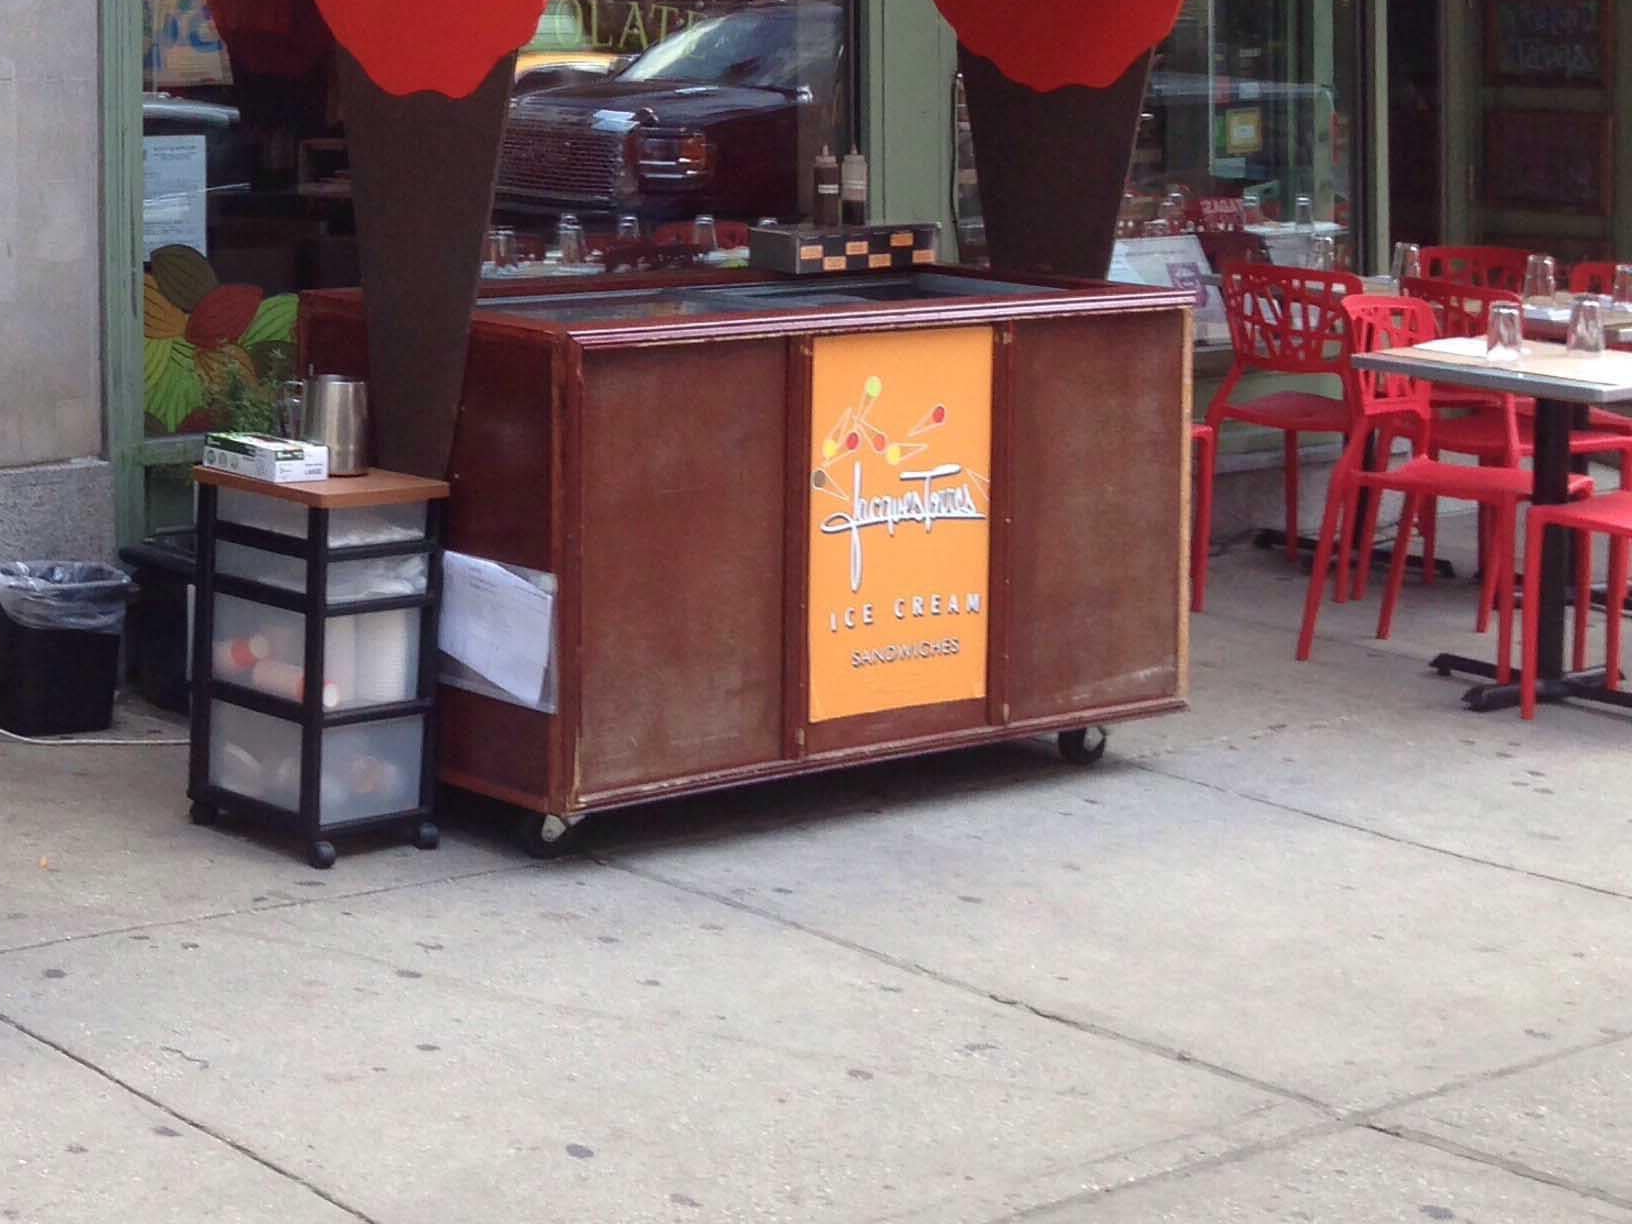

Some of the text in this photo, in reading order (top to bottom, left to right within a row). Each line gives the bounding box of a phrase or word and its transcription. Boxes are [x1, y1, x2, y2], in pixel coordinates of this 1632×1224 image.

[829, 593, 982, 633] ICE CREAM
[851, 638, 961, 669] SANDWICHES
